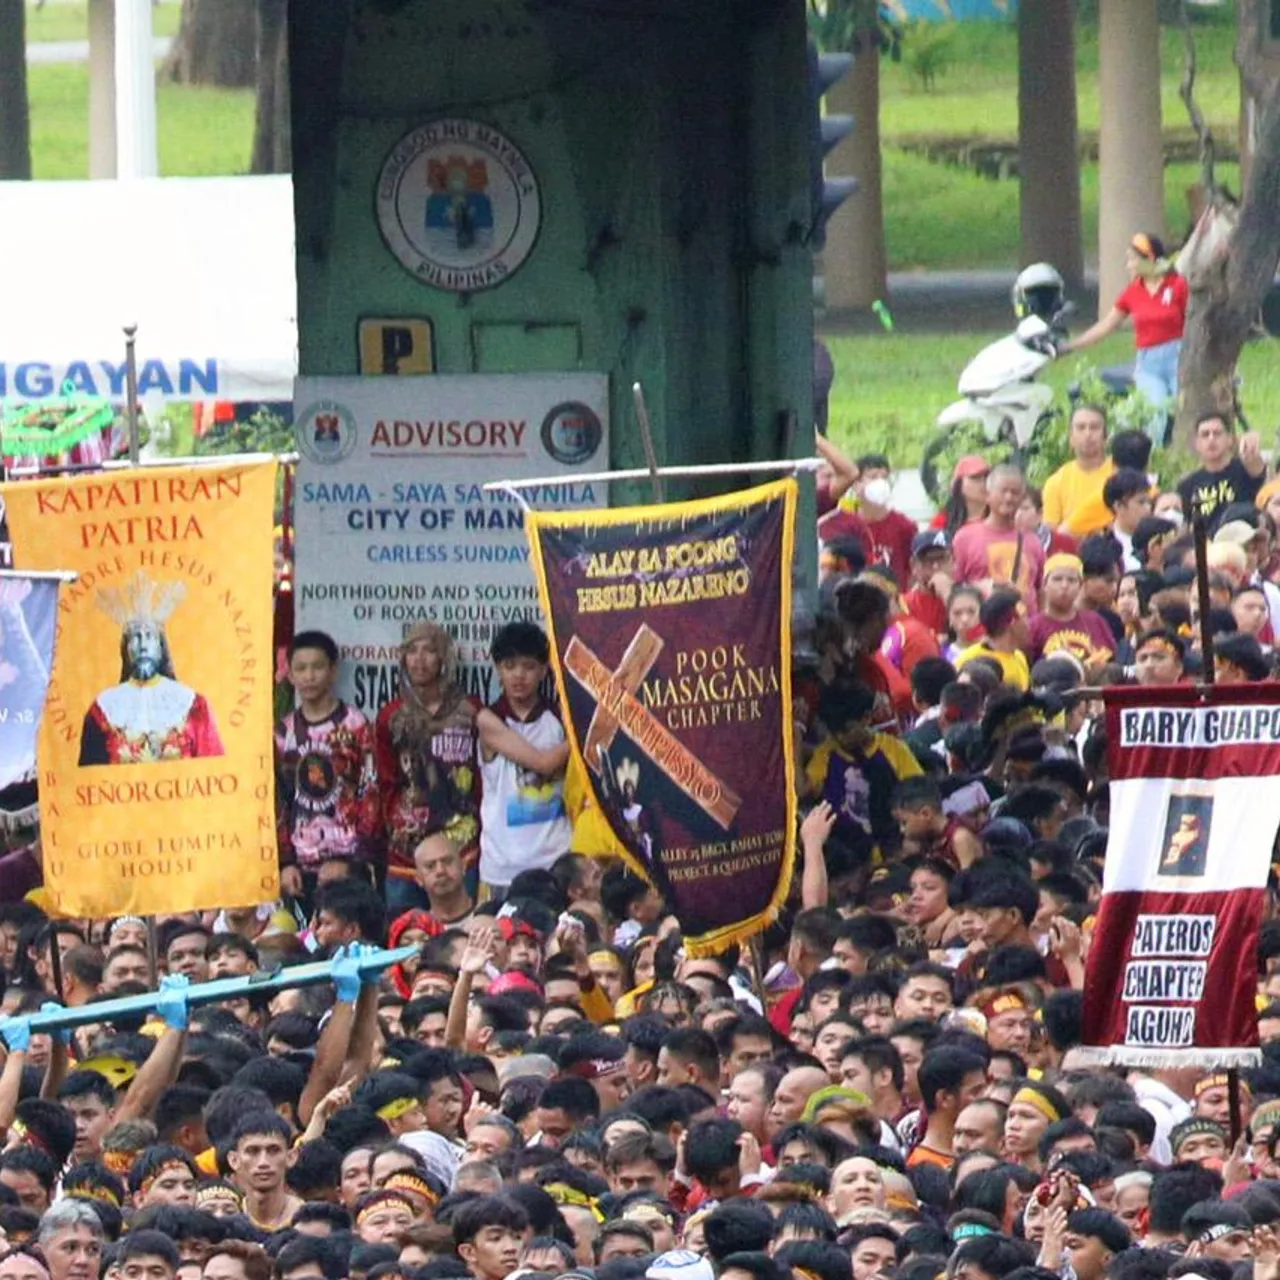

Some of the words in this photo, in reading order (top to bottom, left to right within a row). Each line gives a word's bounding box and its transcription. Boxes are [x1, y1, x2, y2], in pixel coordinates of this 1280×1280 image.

[370, 420, 527, 448] ADVISORY
[37, 471, 243, 515] KAPATIRAN
[303, 482, 371, 502] SAMA
[393, 483, 446, 503] SAYA
[455, 484, 482, 503] SA
[489, 482, 596, 503] MAYNILA
[80, 514, 204, 549] PATRIA
[347, 510, 407, 531] CITY
[420, 510, 456, 531] OF
[465, 509, 524, 530] MAN
[140, 551, 215, 587] HESUS
[367, 545, 447, 563] CARLESS
[586, 550, 635, 578] ALAY
[638, 548, 663, 574] SA
[665, 535, 737, 571] POONG
[302, 584, 426, 600] NORTHBOUND
[434, 584, 470, 600] AND
[640, 567, 751, 607] NAZARENO
[354, 605, 376, 620] OF
[382, 605, 438, 620] ROXAS
[677, 643, 746, 676] POOK
[642, 665, 779, 709] MASAGANA
[667, 700, 762, 729] CHAPTER
[76, 776, 150, 807] SEÑOR
[154, 773, 239, 802] GUAPO
[120, 858, 195, 878] HOUSE
[1135, 919, 1212, 955] PATEROS
